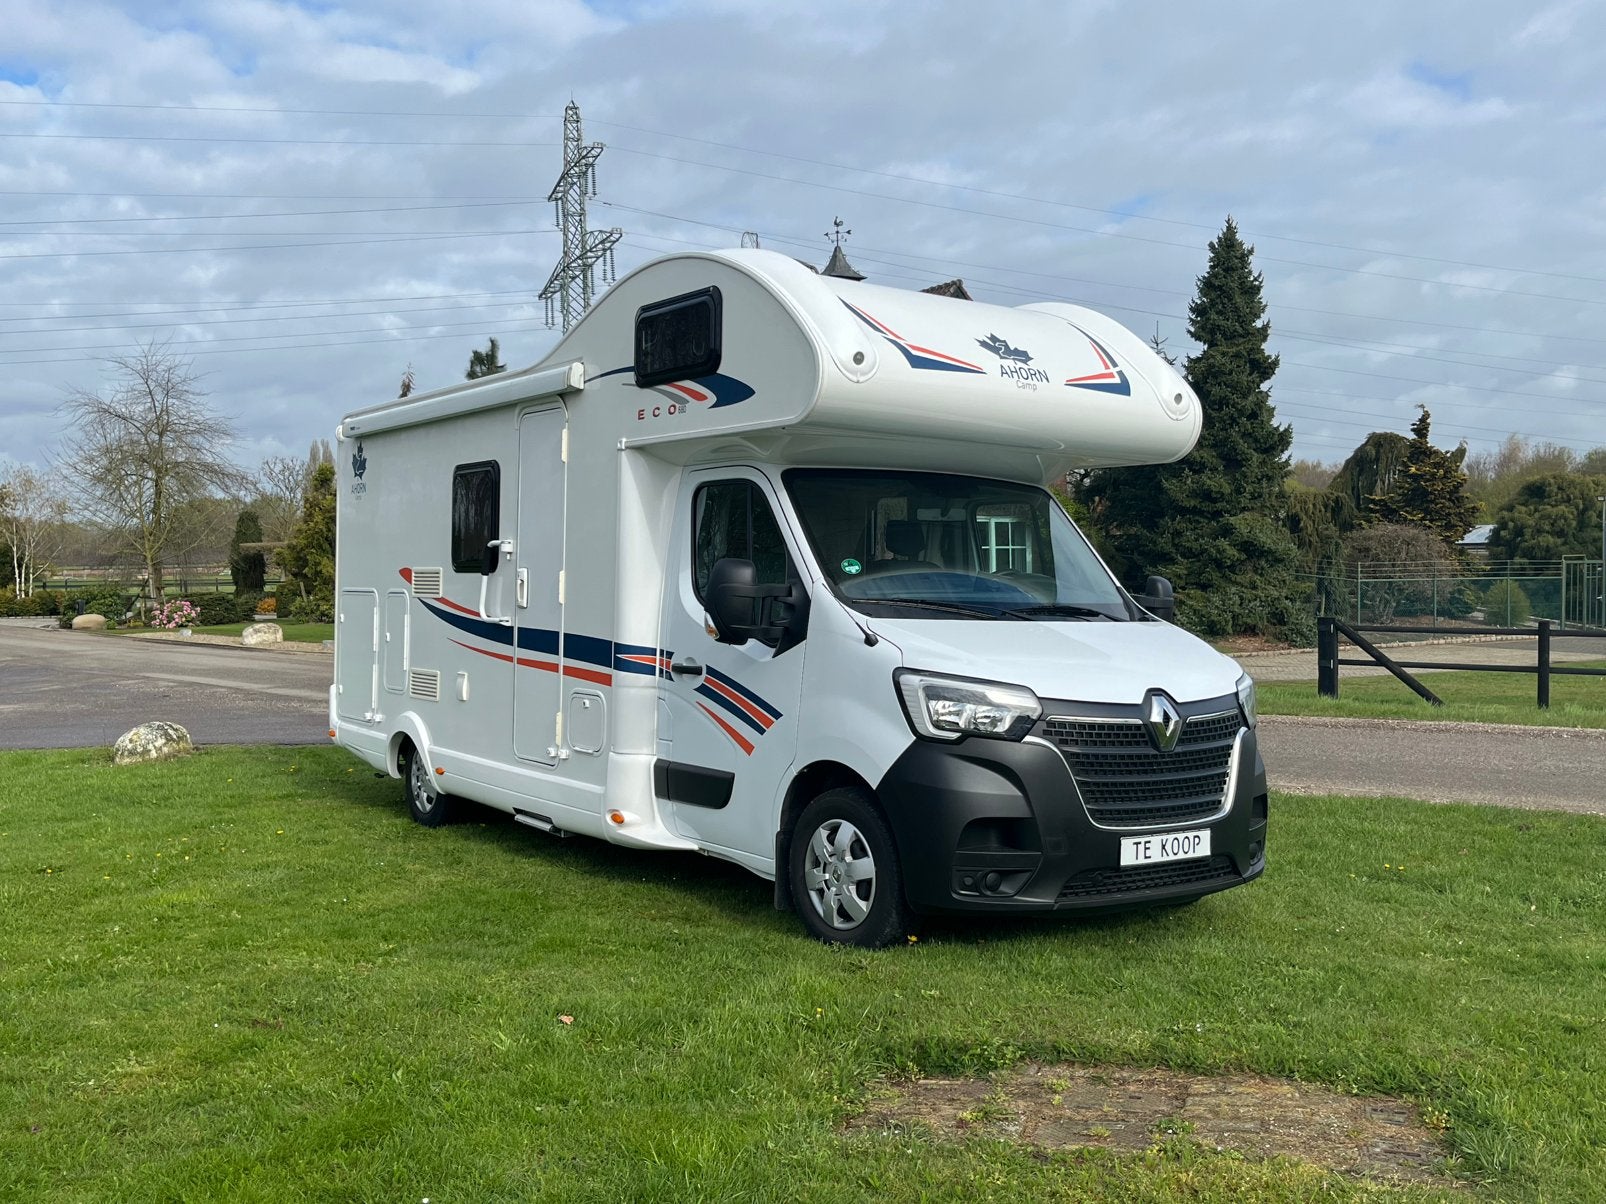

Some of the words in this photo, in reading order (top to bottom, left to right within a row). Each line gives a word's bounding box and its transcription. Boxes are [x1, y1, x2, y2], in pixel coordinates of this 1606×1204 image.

[1000, 364, 1050, 383] AHORN
[1016, 379, 1038, 391] Camp
[1132, 840, 1151, 860] TE
[1161, 835, 1201, 857] KOOP
